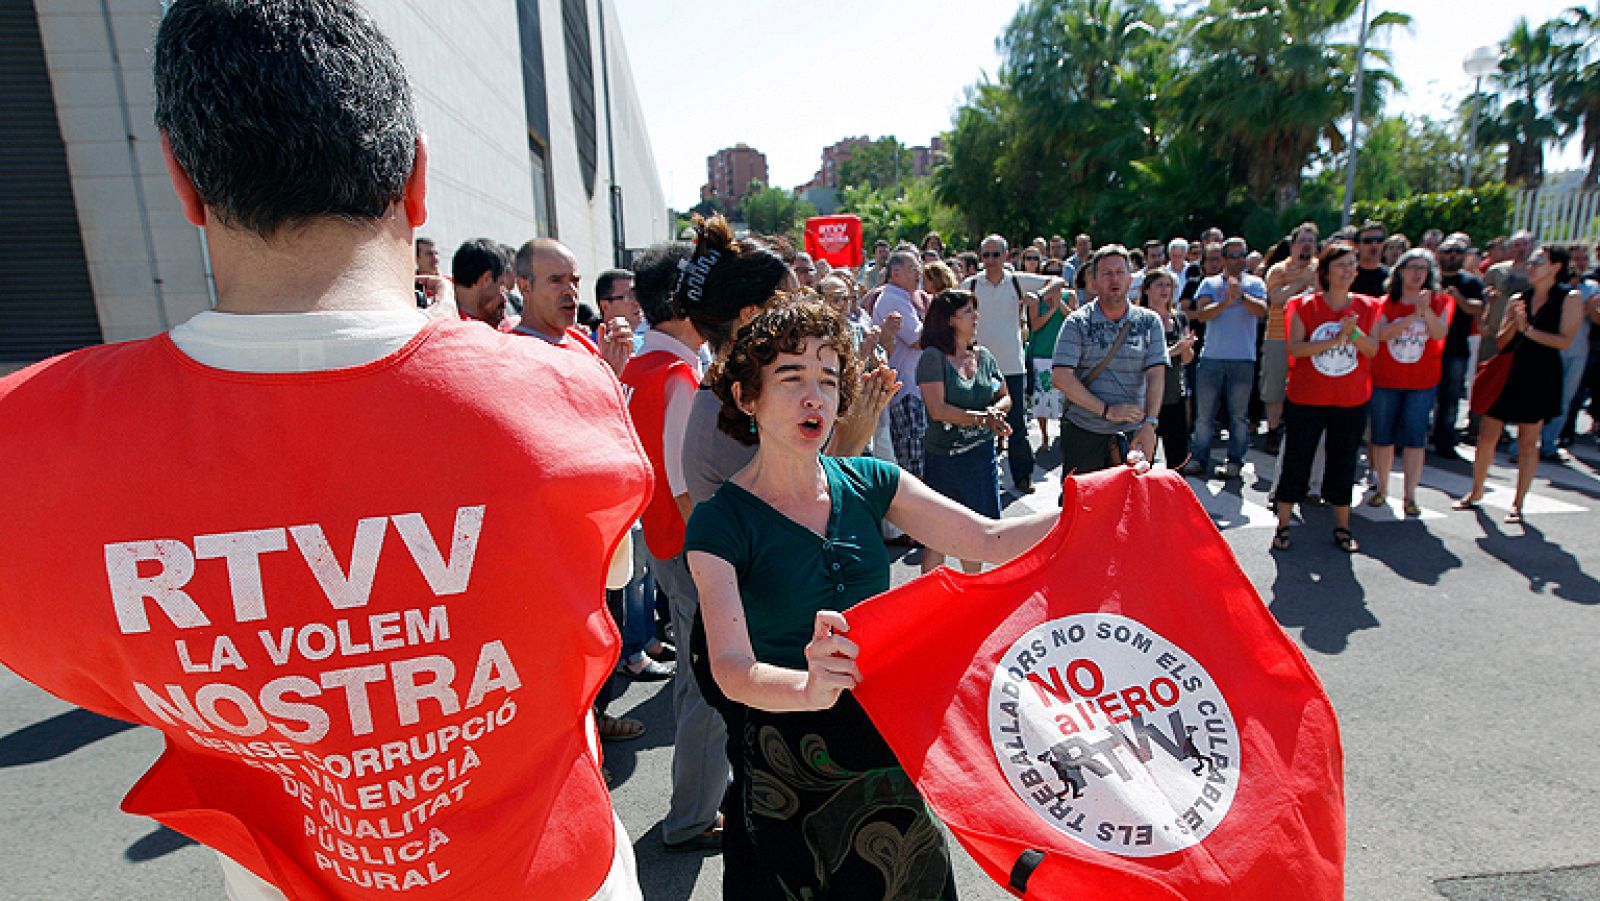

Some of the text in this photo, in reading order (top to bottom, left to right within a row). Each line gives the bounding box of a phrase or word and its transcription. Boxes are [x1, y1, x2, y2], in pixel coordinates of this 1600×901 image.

[104, 505, 486, 634] RTVV
[175, 605, 451, 673] LA VOLEM
[1052, 625, 1085, 647] NO
[1096, 623, 1152, 653] SOM
[133, 640, 522, 744] NOSTRA
[1025, 658, 1104, 707] NO
[1156, 653, 1202, 693] ELS
[187, 697, 517, 778] SENSE CORRUPCIÓ
[1000, 639, 1086, 832] TREBALLADORS
[301, 746, 481, 810] VALENCIÀ
[281, 775, 471, 839] DE QUALITAT
[1097, 822, 1153, 845] ELS
[304, 815, 450, 865] PÚBLICA
[314, 851, 450, 891] PLURAL
